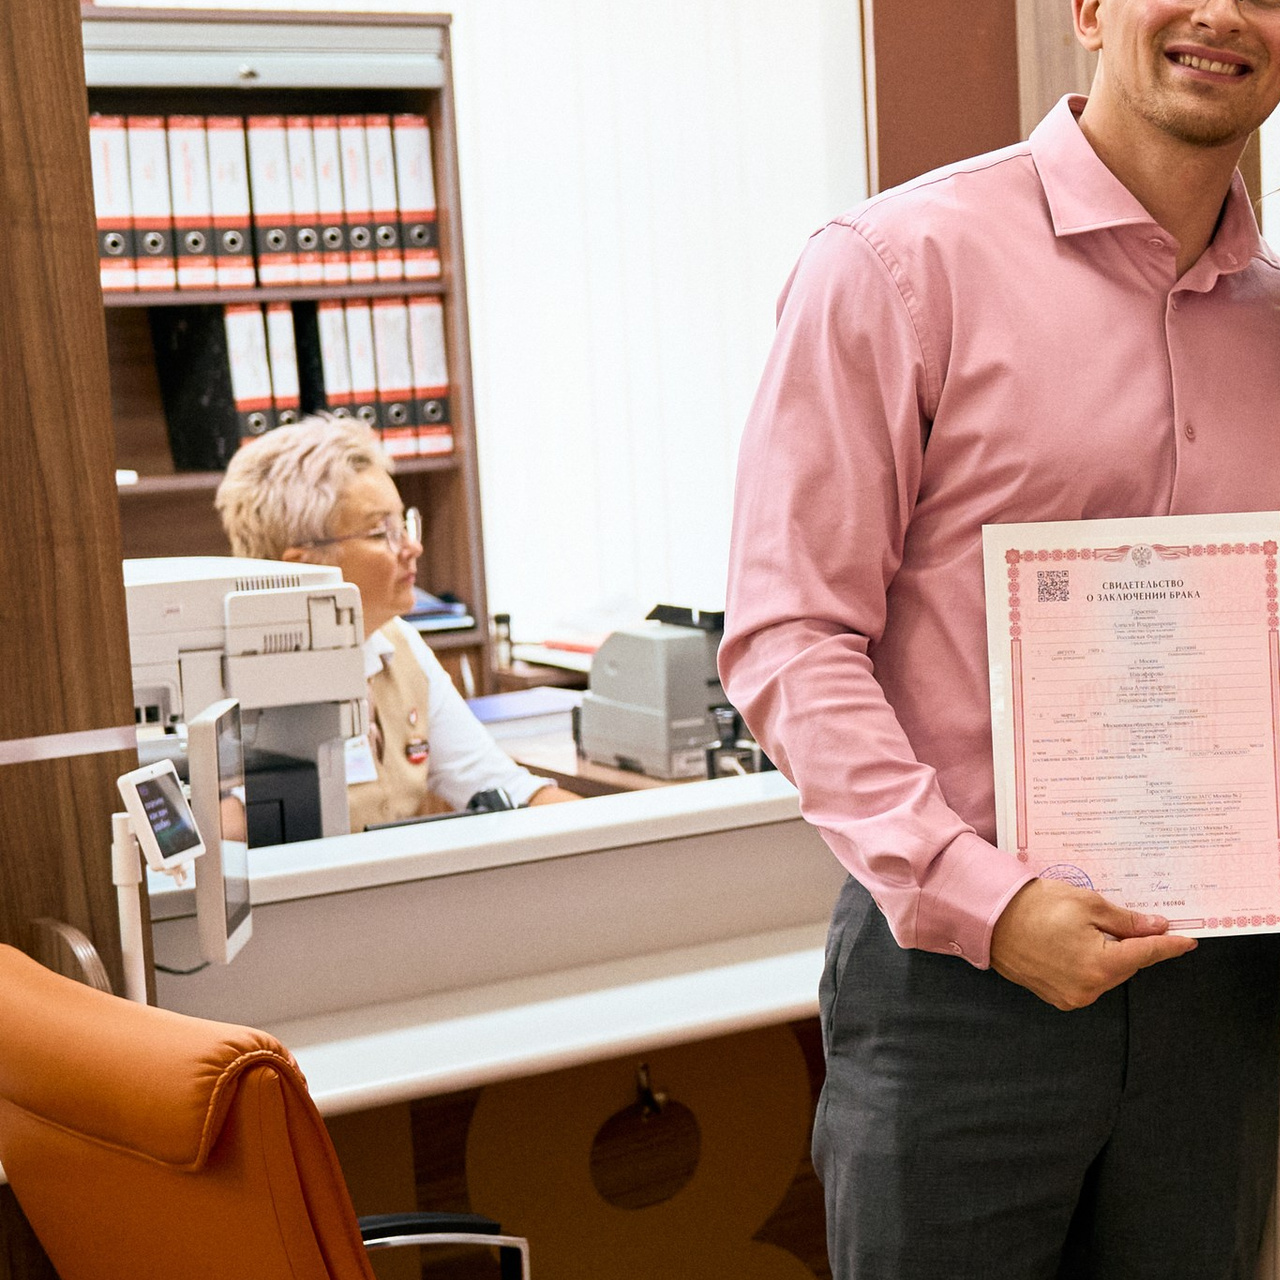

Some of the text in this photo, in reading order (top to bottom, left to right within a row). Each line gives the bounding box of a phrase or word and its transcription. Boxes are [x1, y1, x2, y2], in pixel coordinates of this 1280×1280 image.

[1102, 579, 1184, 590] СВИДЕТЕЛЬСТВО
[1097, 591, 1166, 600] ЗАКЛЮЧЕНИИ
[1169, 590, 1200, 598] БРАКА
